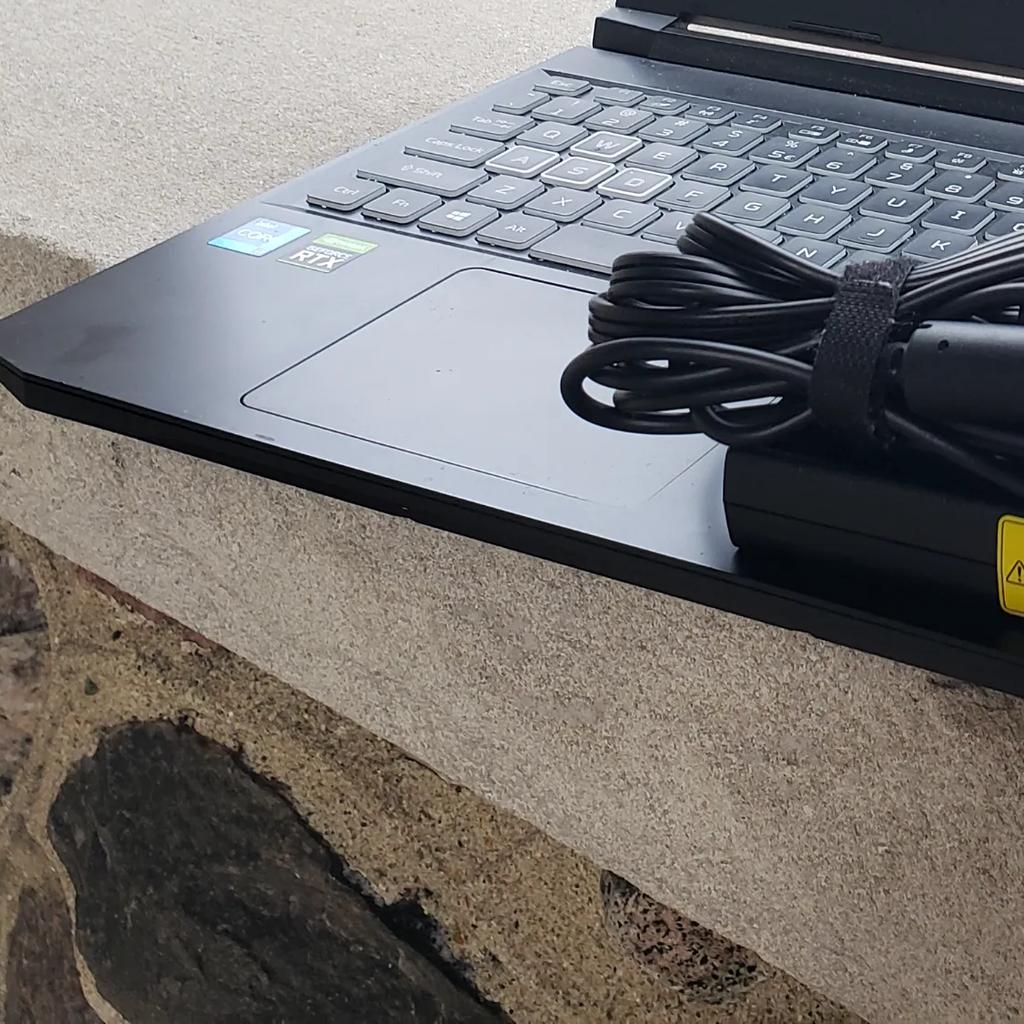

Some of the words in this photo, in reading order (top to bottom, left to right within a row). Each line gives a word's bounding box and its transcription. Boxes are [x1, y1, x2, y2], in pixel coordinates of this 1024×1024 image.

[601, 118, 619, 126] 2
[543, 130, 561, 139] Q
[656, 128, 674, 136] 3
[425, 137, 453, 147] Caps
[455, 143, 483, 153] Lock
[595, 139, 621, 149] W
[712, 139, 729, 147] 4
[653, 151, 672, 160] E
[510, 156, 529, 165] A
[709, 162, 728, 171] R
[826, 161, 844, 170] 6
[567, 166, 589, 175] S
[771, 173, 787, 182] T
[886, 172, 902, 181] 7
[624, 178, 645, 187] D
[334, 186, 359, 196] Ctrl
[495, 185, 516, 195] Z
[830, 185, 847, 195] Y
[944, 184, 962, 193] 8
[684, 190, 704, 198] F
[392, 199, 409, 208] Fn
[552, 196, 573, 207] X
[887, 197, 906, 208] U
[1006, 196, 1023, 205] 9
[743, 202, 762, 211] G
[613, 209, 632, 218] C
[951, 210, 966, 220] I
[803, 213, 825, 224] H
[505, 224, 526, 233] Alt
[866, 228, 886, 237] J
[930, 239, 951, 251] K
[796, 247, 818, 258] N
[289, 249, 345, 269] RTX
